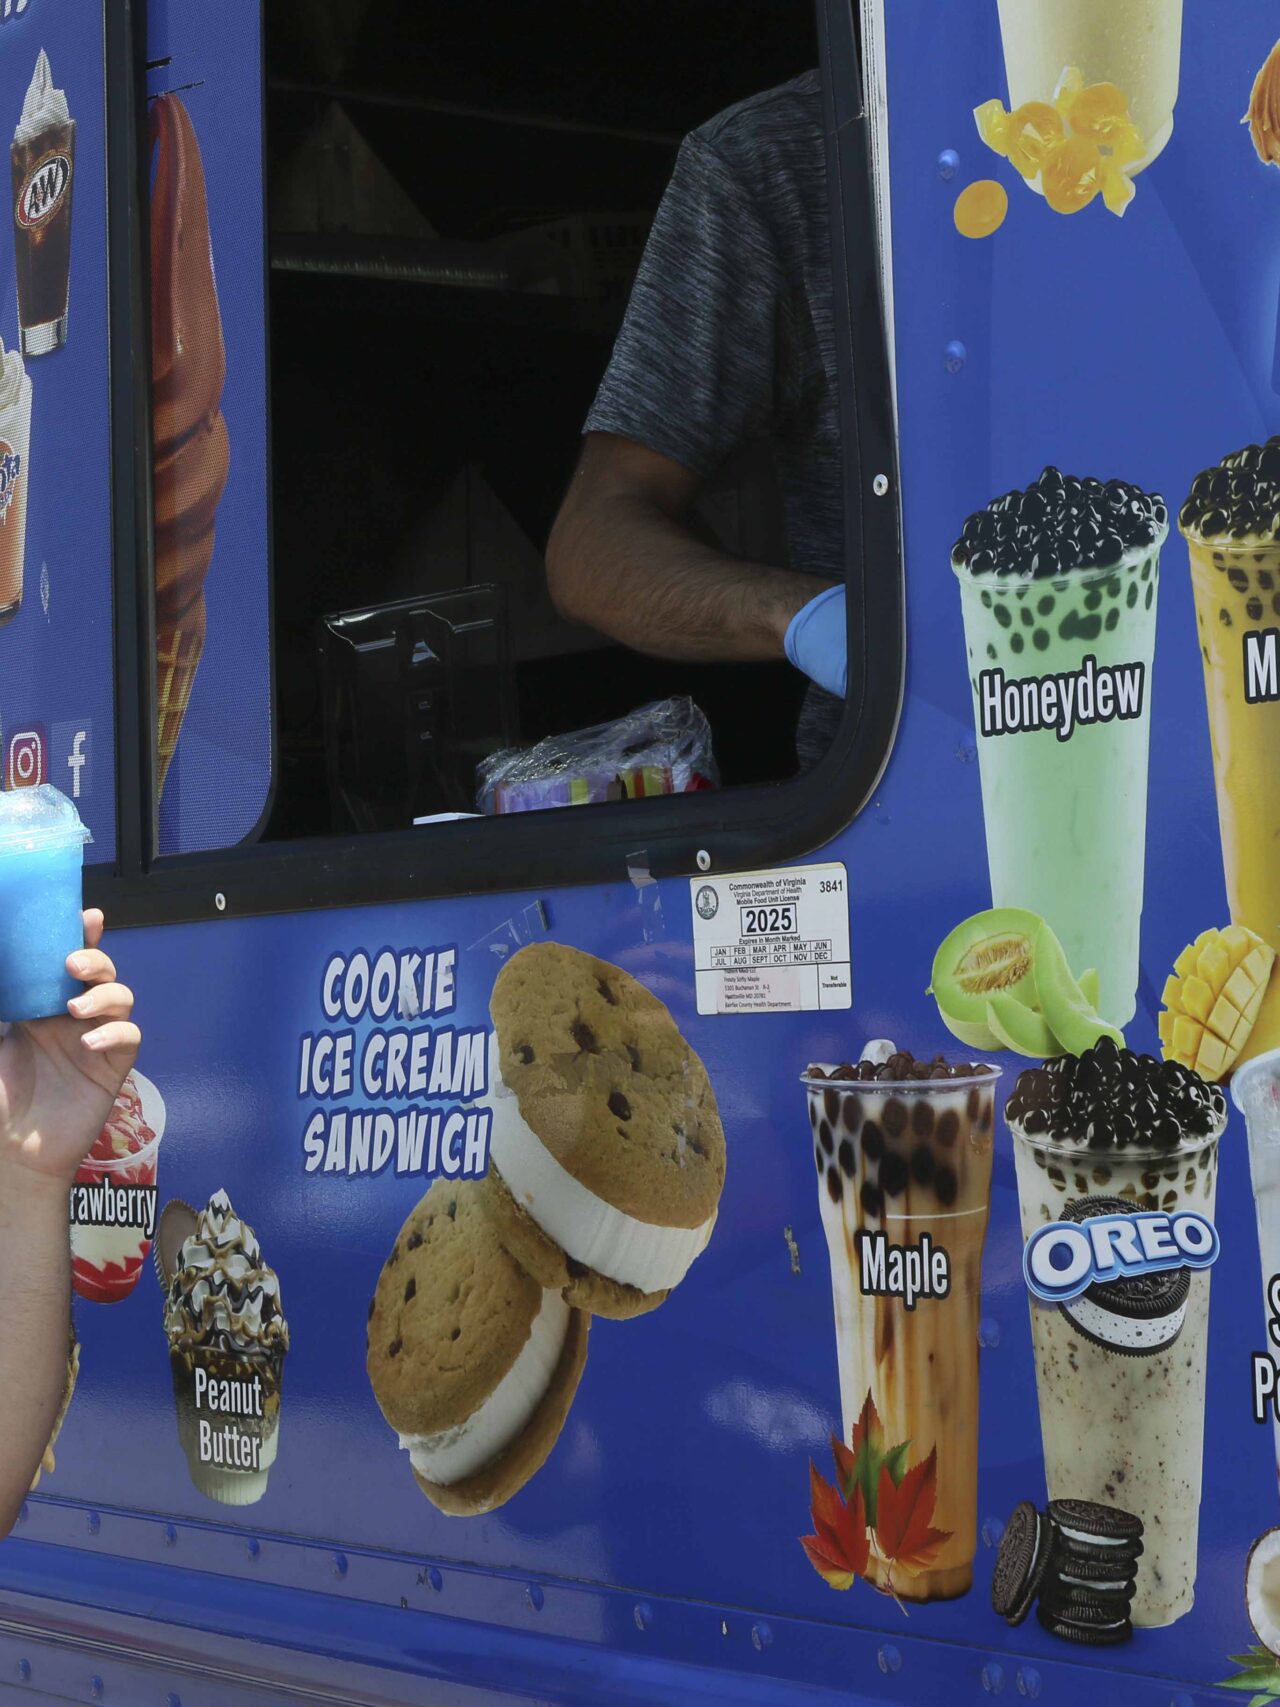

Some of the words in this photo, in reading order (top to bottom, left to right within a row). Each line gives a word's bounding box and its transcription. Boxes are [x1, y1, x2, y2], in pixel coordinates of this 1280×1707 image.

[983, 661, 1141, 737] Honeydew
[729, 880, 774, 891] Commonwealth
[776, 879, 782, 888] of
[782, 877, 806, 888] Virginia
[733, 891, 751, 899] Virginia
[752, 888, 779, 897] Department
[820, 880, 842, 893] 3841
[746, 907, 792, 933] 2025
[781, 934, 801, 942] Marked
[715, 948, 726, 956] JAN
[773, 944, 786, 952] APR
[793, 943, 807, 951] MAY
[814, 942, 827, 950] JUN
[715, 958, 727, 966] JUL
[752, 955, 768, 963] SEPT
[773, 954, 787, 962] OCT
[794, 953, 807, 961] NOV
[814, 952, 828, 960] DEC
[323, 949, 455, 1019] COOKIE
[299, 1034, 353, 1095] ICE
[363, 1031, 485, 1097] CREAM
[303, 1110, 489, 1175] SANDWICH
[70, 1177, 157, 1235] rawberry
[862, 1234, 948, 1304] Maple
[1030, 1216, 1214, 1288] OREO
[195, 1366, 262, 1416] Peanut
[199, 1420, 261, 1468] Butter
